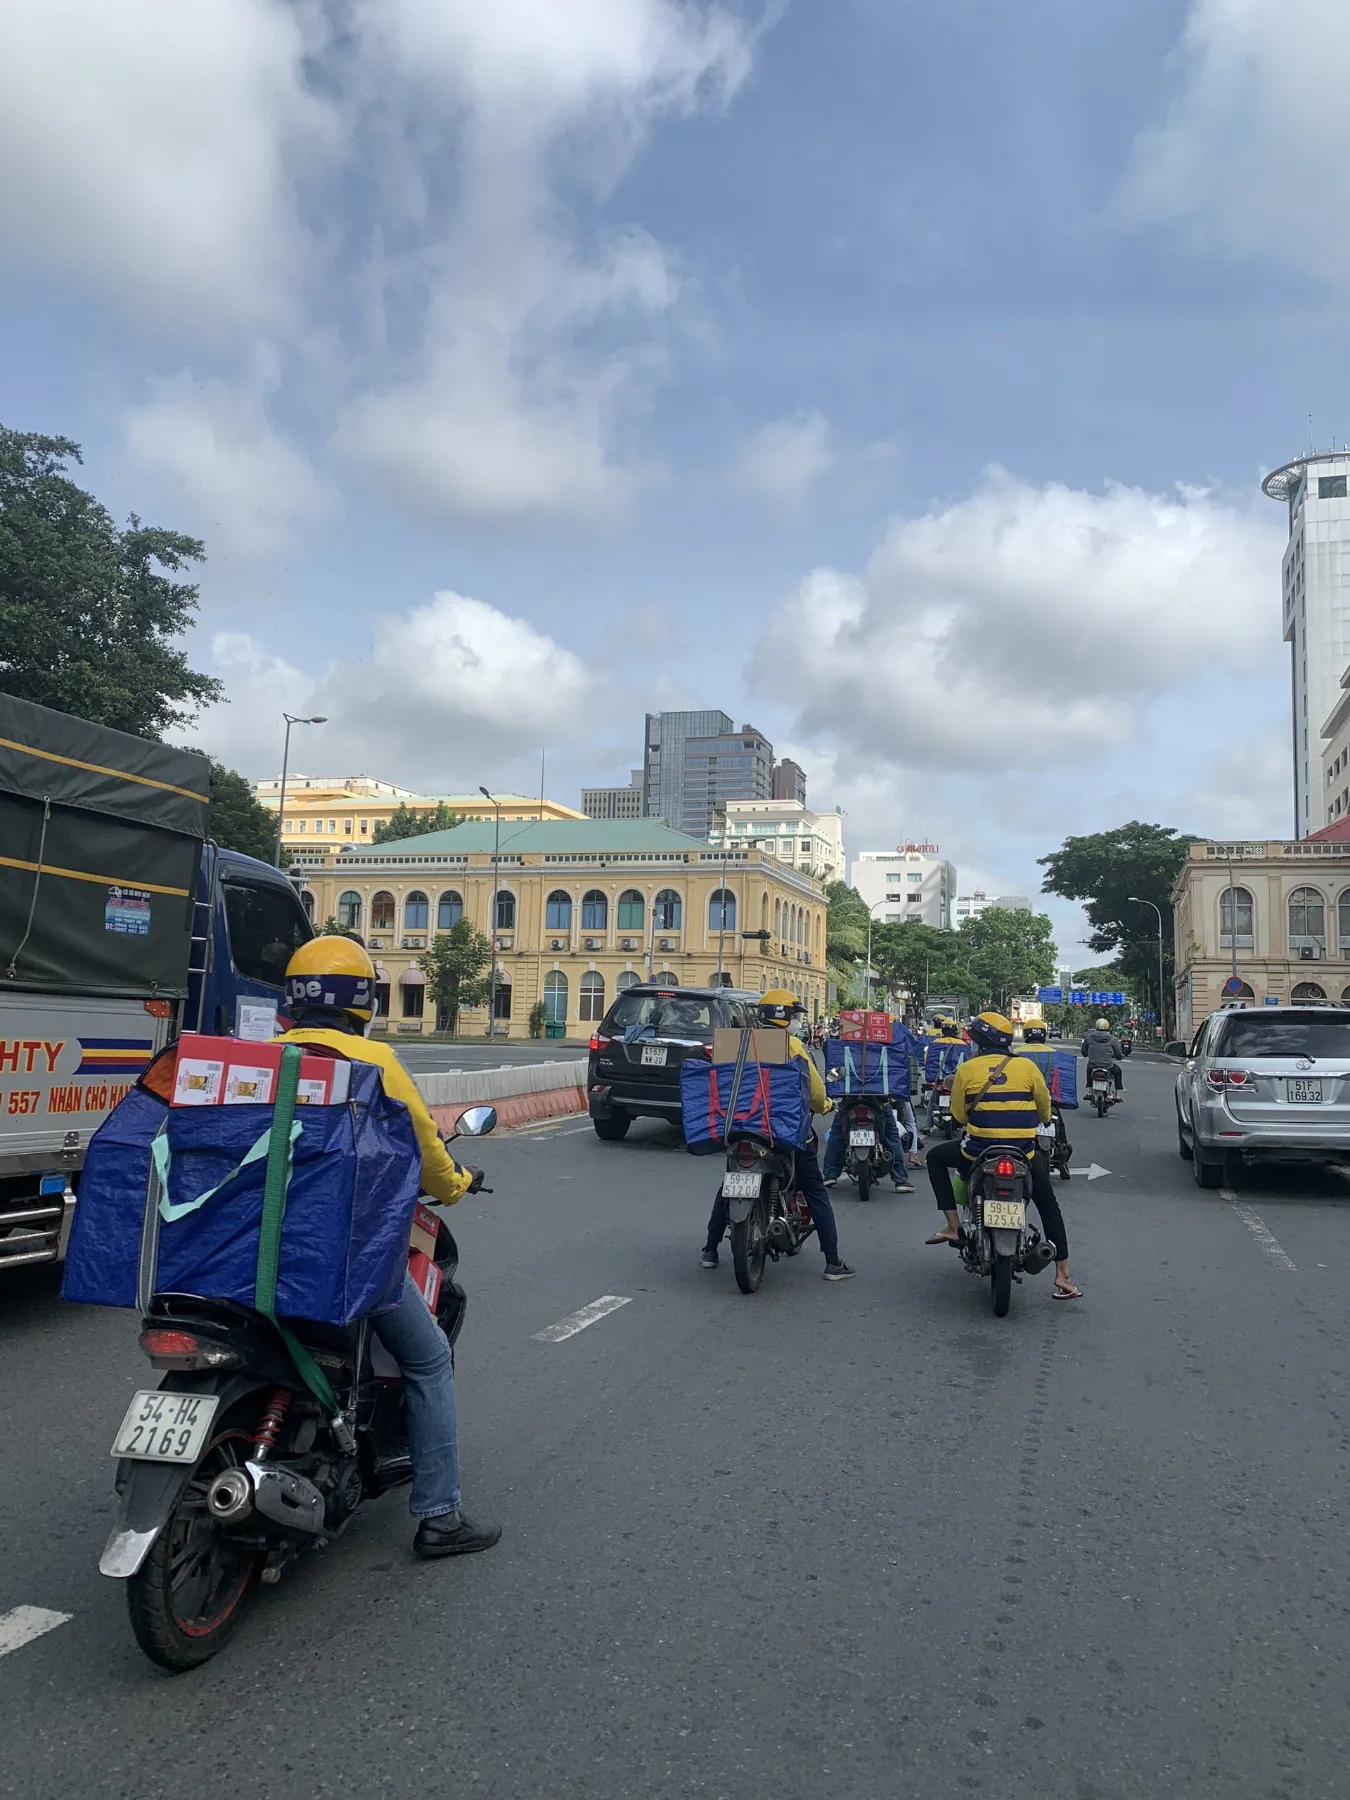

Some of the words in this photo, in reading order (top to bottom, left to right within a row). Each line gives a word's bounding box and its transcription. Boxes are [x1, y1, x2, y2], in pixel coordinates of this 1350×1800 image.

[1295, 1080, 1313, 1091] 51F
[7, 1090, 41, 1114] 557
[990, 1202, 1019, 1215] 59-L2
[139, 1395, 201, 1426] 54-H4
[125, 1424, 192, 1456] 2169
